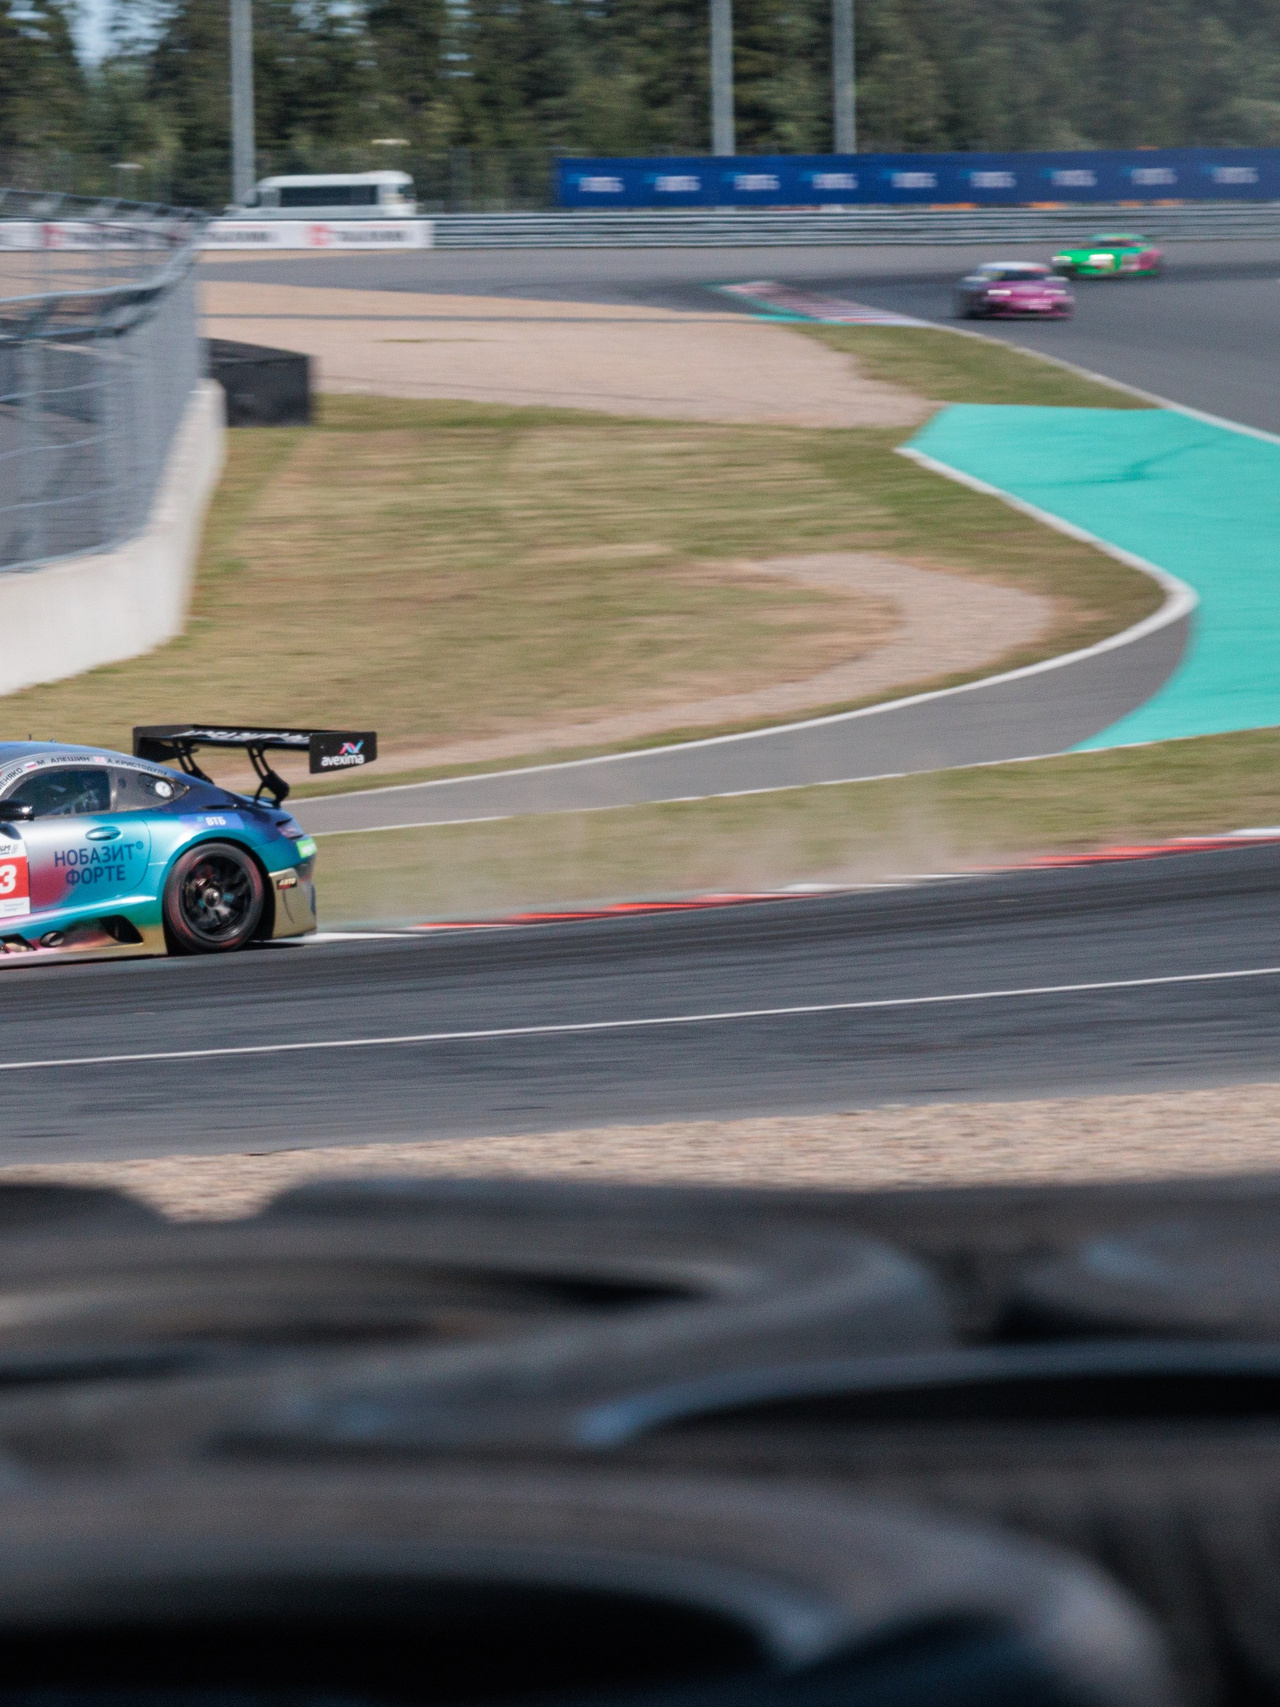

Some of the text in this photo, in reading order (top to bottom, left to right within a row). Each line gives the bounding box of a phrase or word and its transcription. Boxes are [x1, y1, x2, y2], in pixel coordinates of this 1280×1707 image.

[50, 756, 90, 764] АЛЕШИН
[321, 753, 365, 767] avexima
[205, 816, 227, 826] ВТБ
[65, 864, 126, 886] ФОРТЕ
